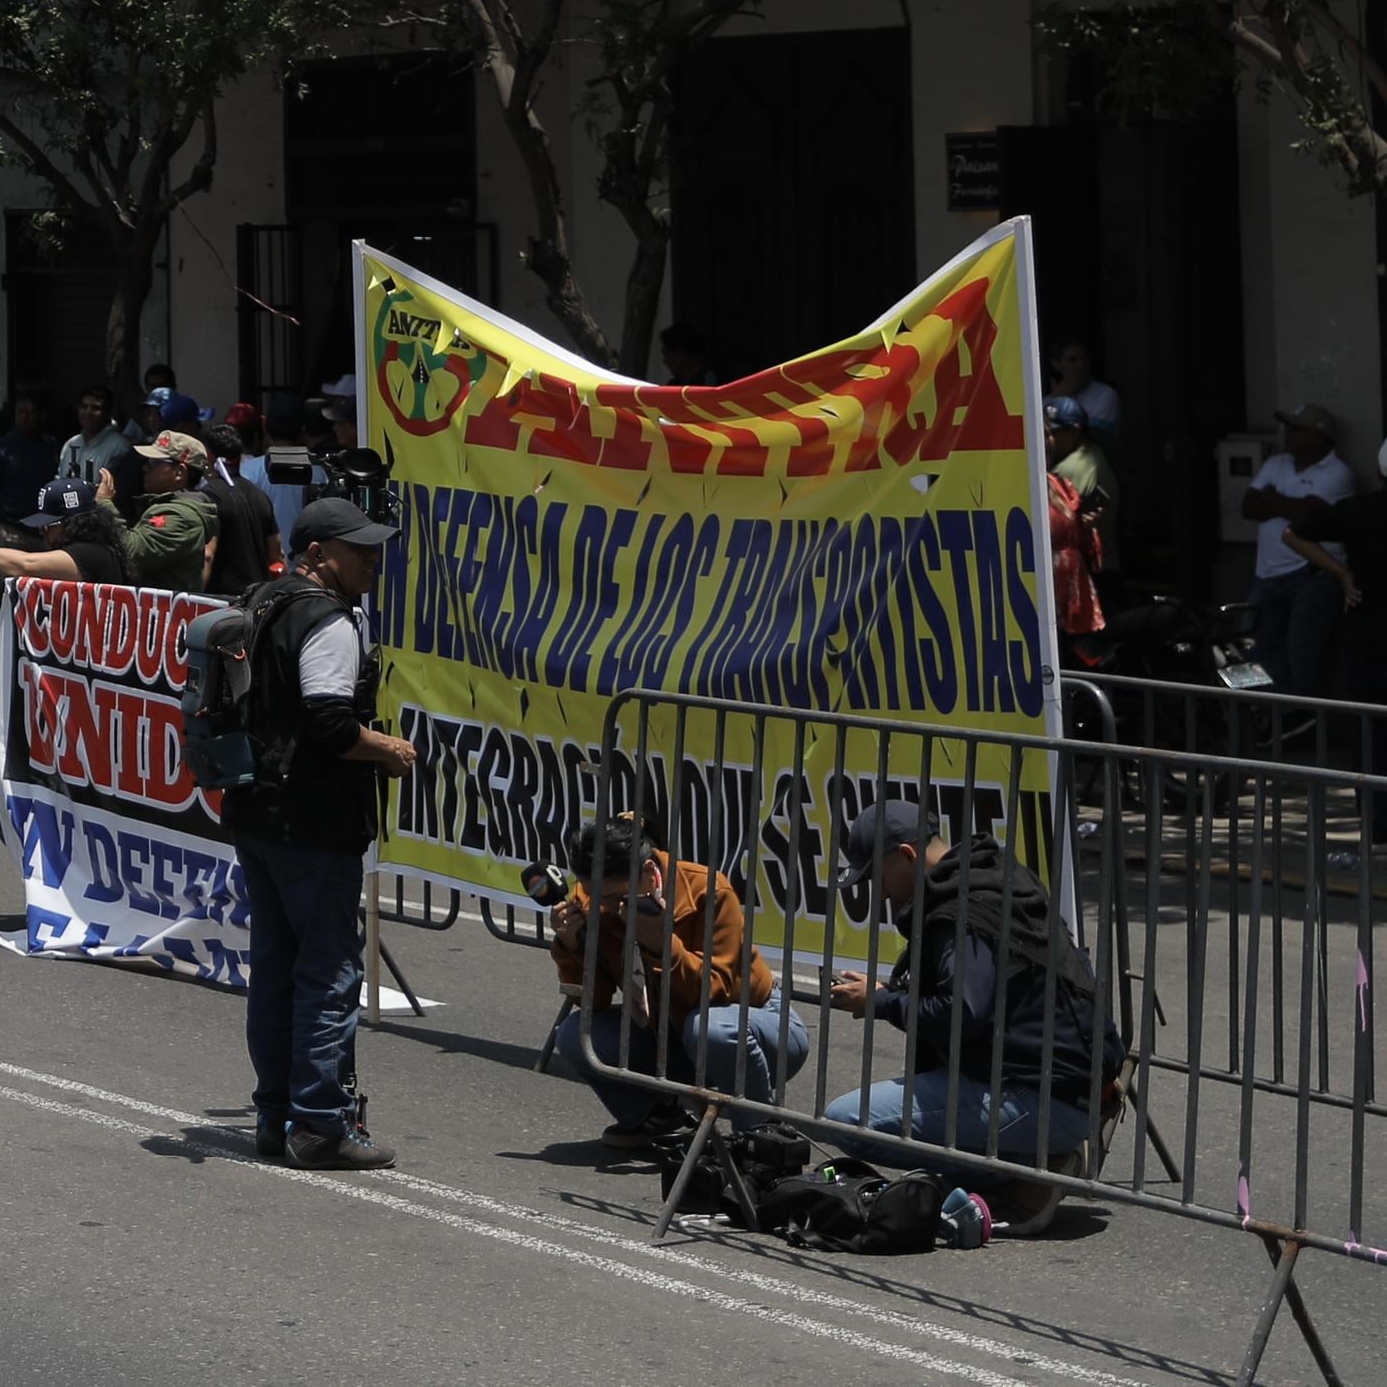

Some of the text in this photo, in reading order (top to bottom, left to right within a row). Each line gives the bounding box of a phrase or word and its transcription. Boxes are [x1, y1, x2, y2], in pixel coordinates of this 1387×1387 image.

[414, 485, 568, 683] DEFENSA
[544, 504, 639, 694] DE
[596, 512, 720, 697] LOS
[396, 701, 671, 871] INTEGRACÓN
